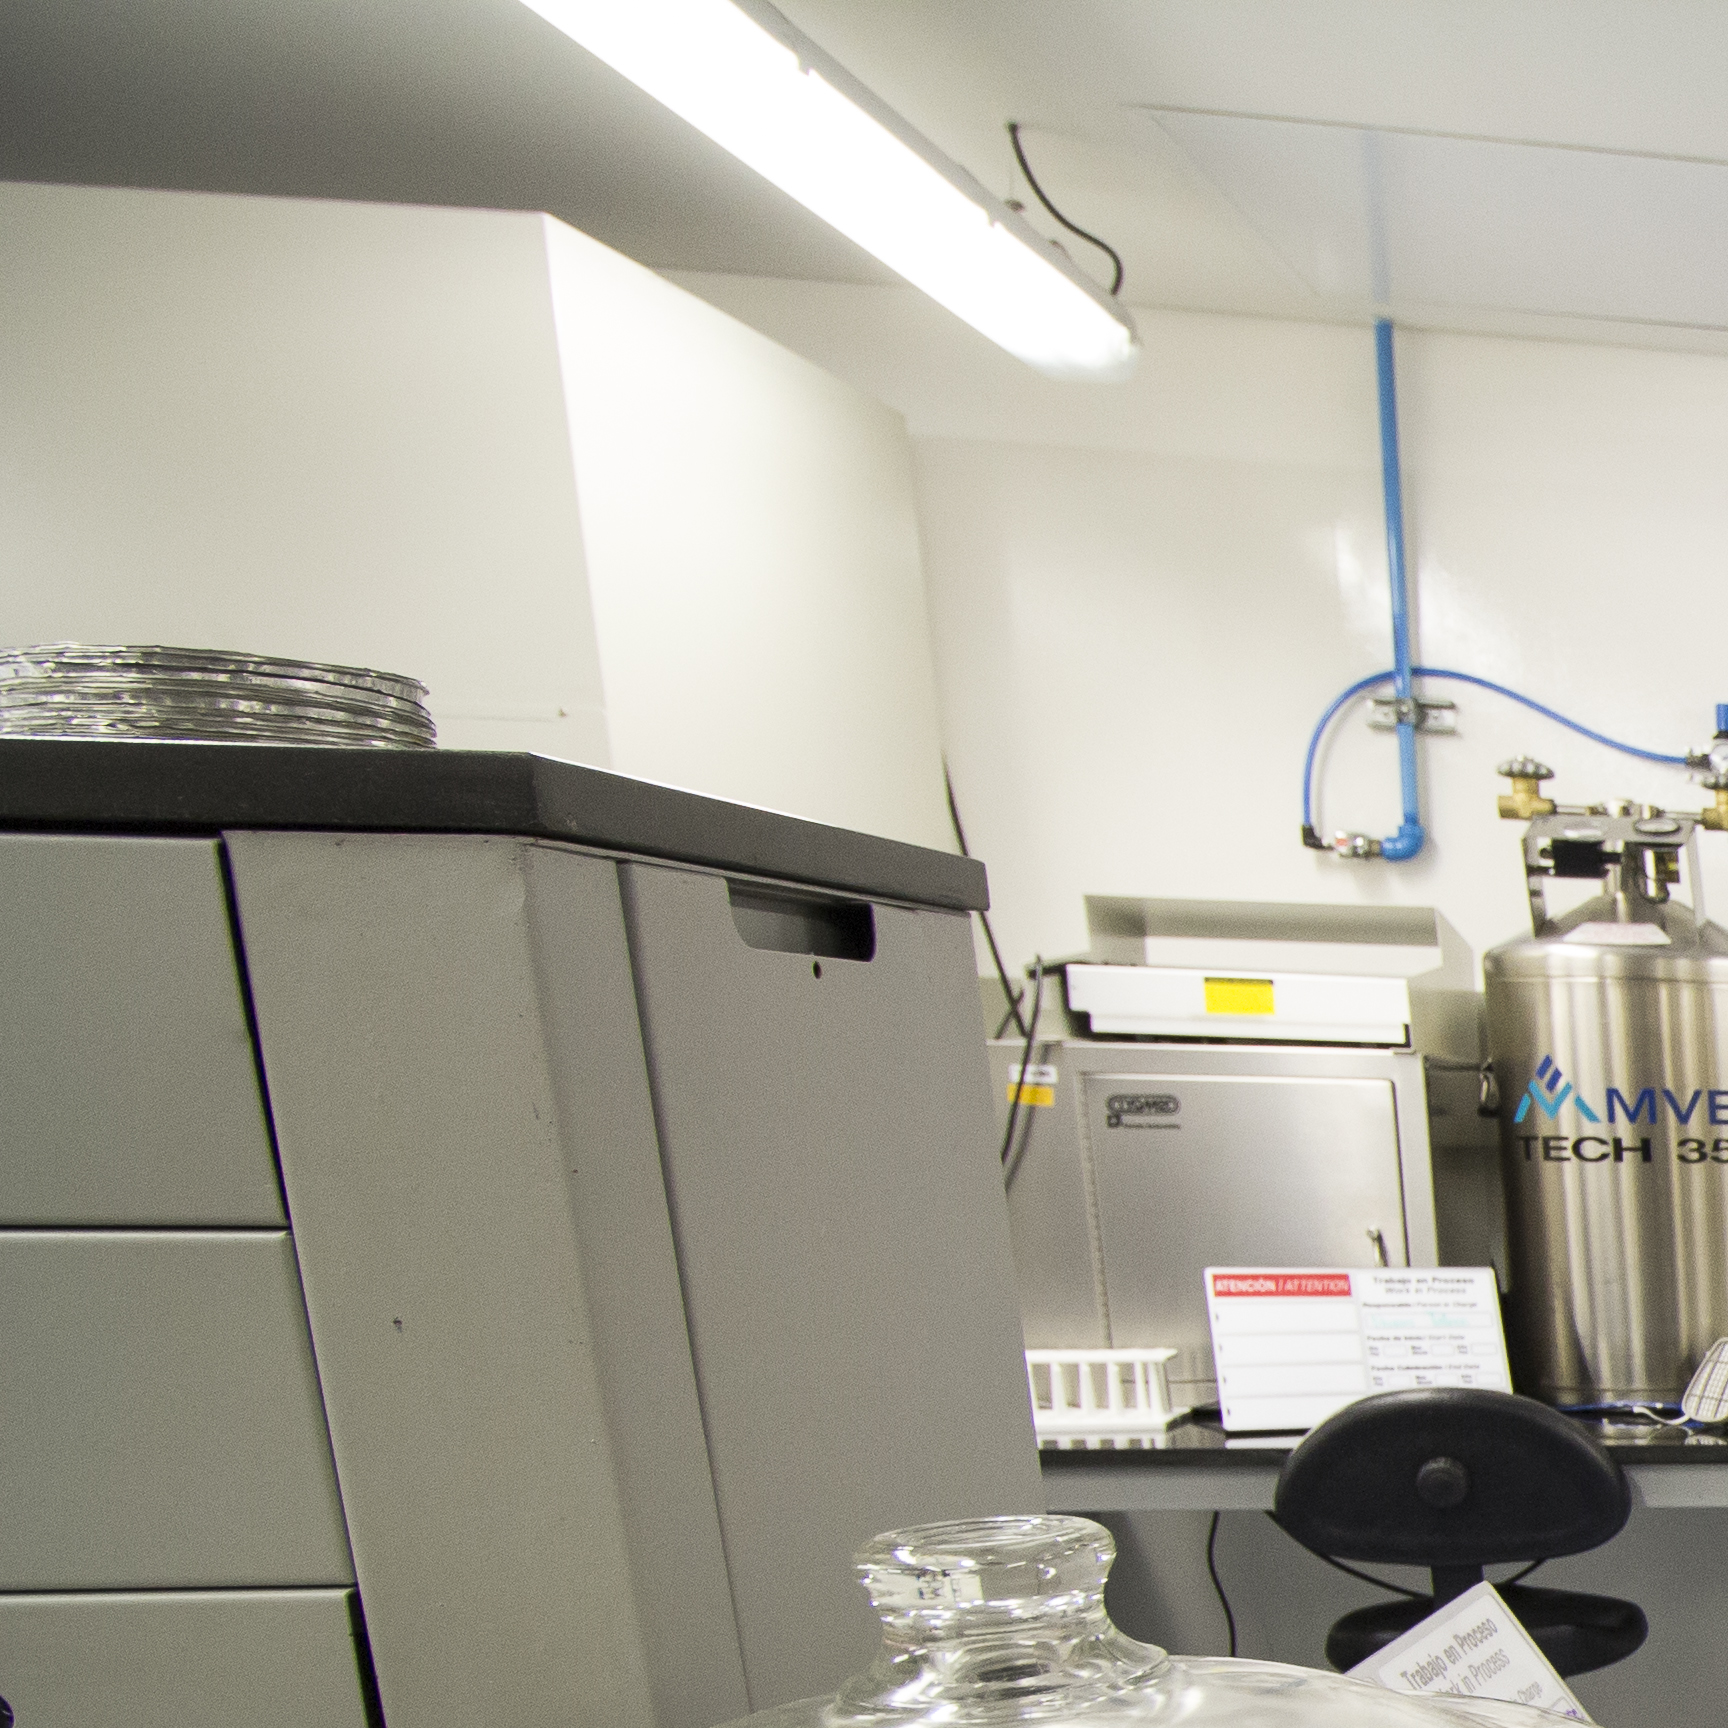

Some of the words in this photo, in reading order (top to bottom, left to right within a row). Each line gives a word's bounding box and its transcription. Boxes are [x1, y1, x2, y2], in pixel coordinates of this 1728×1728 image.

[1517, 1135, 1653, 1163] TECH
[1214, 1276, 1277, 1293] ATENCIÓN
[1284, 1276, 1350, 1293] ATTENTION
[1400, 1653, 1448, 1690] Trabajo
[1442, 1643, 1462, 1666] en
[1453, 1618, 1498, 1656] Proceso
[1457, 1673, 1475, 1695] in
[1467, 1648, 1510, 1687] Process
